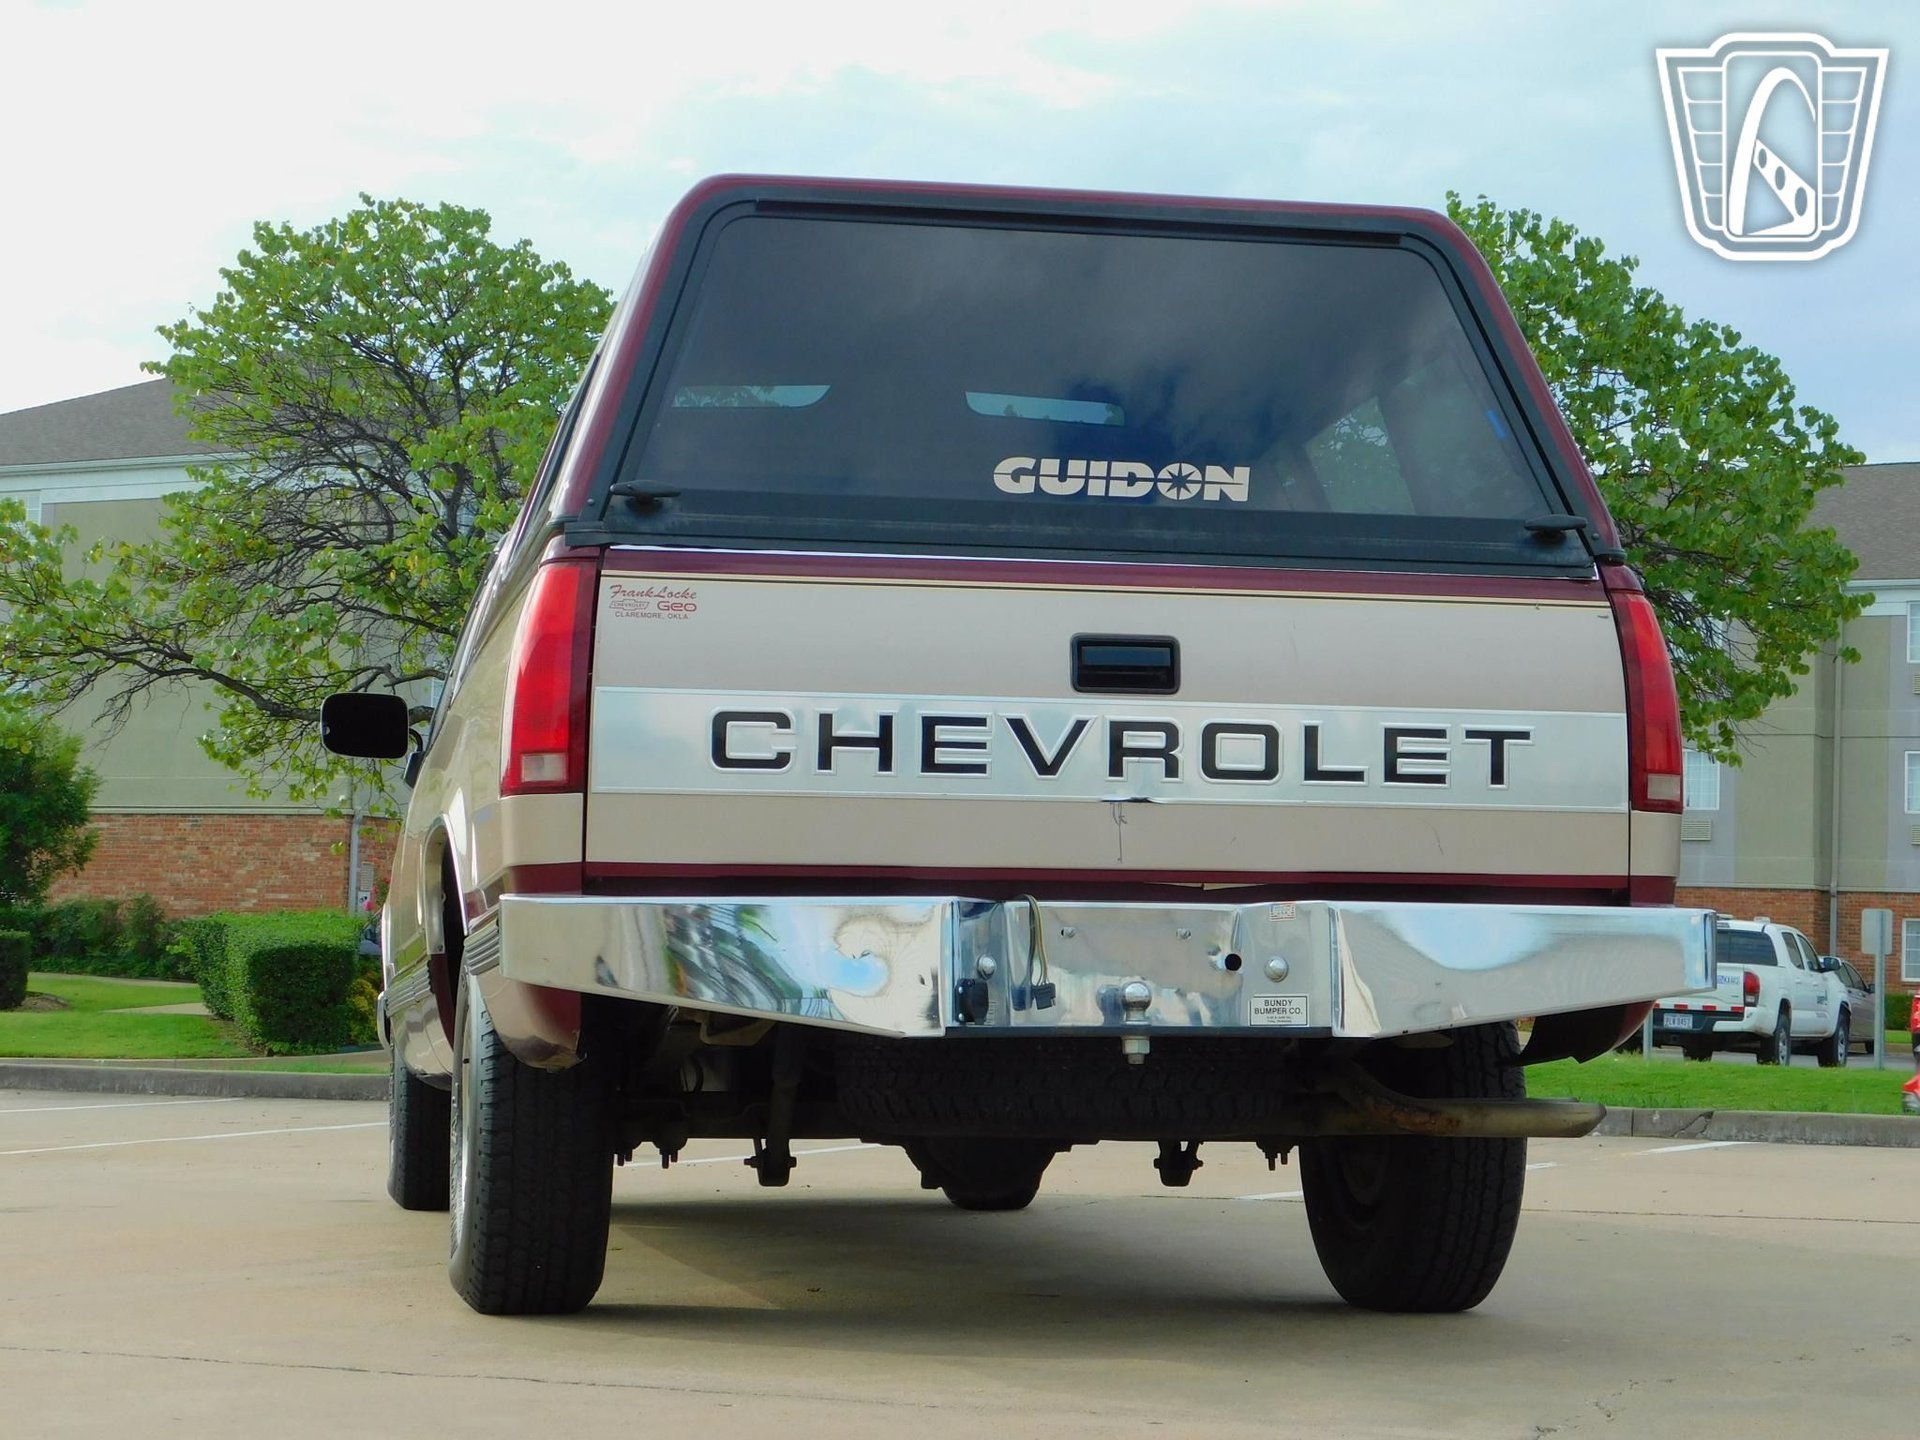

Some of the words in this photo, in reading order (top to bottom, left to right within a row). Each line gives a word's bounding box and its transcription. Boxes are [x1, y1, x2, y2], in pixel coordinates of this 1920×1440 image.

[993, 457, 1250, 502] GUIDON
[609, 584, 654, 599] Frank
[709, 707, 1534, 789] CHEVROLET
[1264, 999, 1293, 1007] BUNDY
[1254, 1007, 1287, 1015] BUMPER
